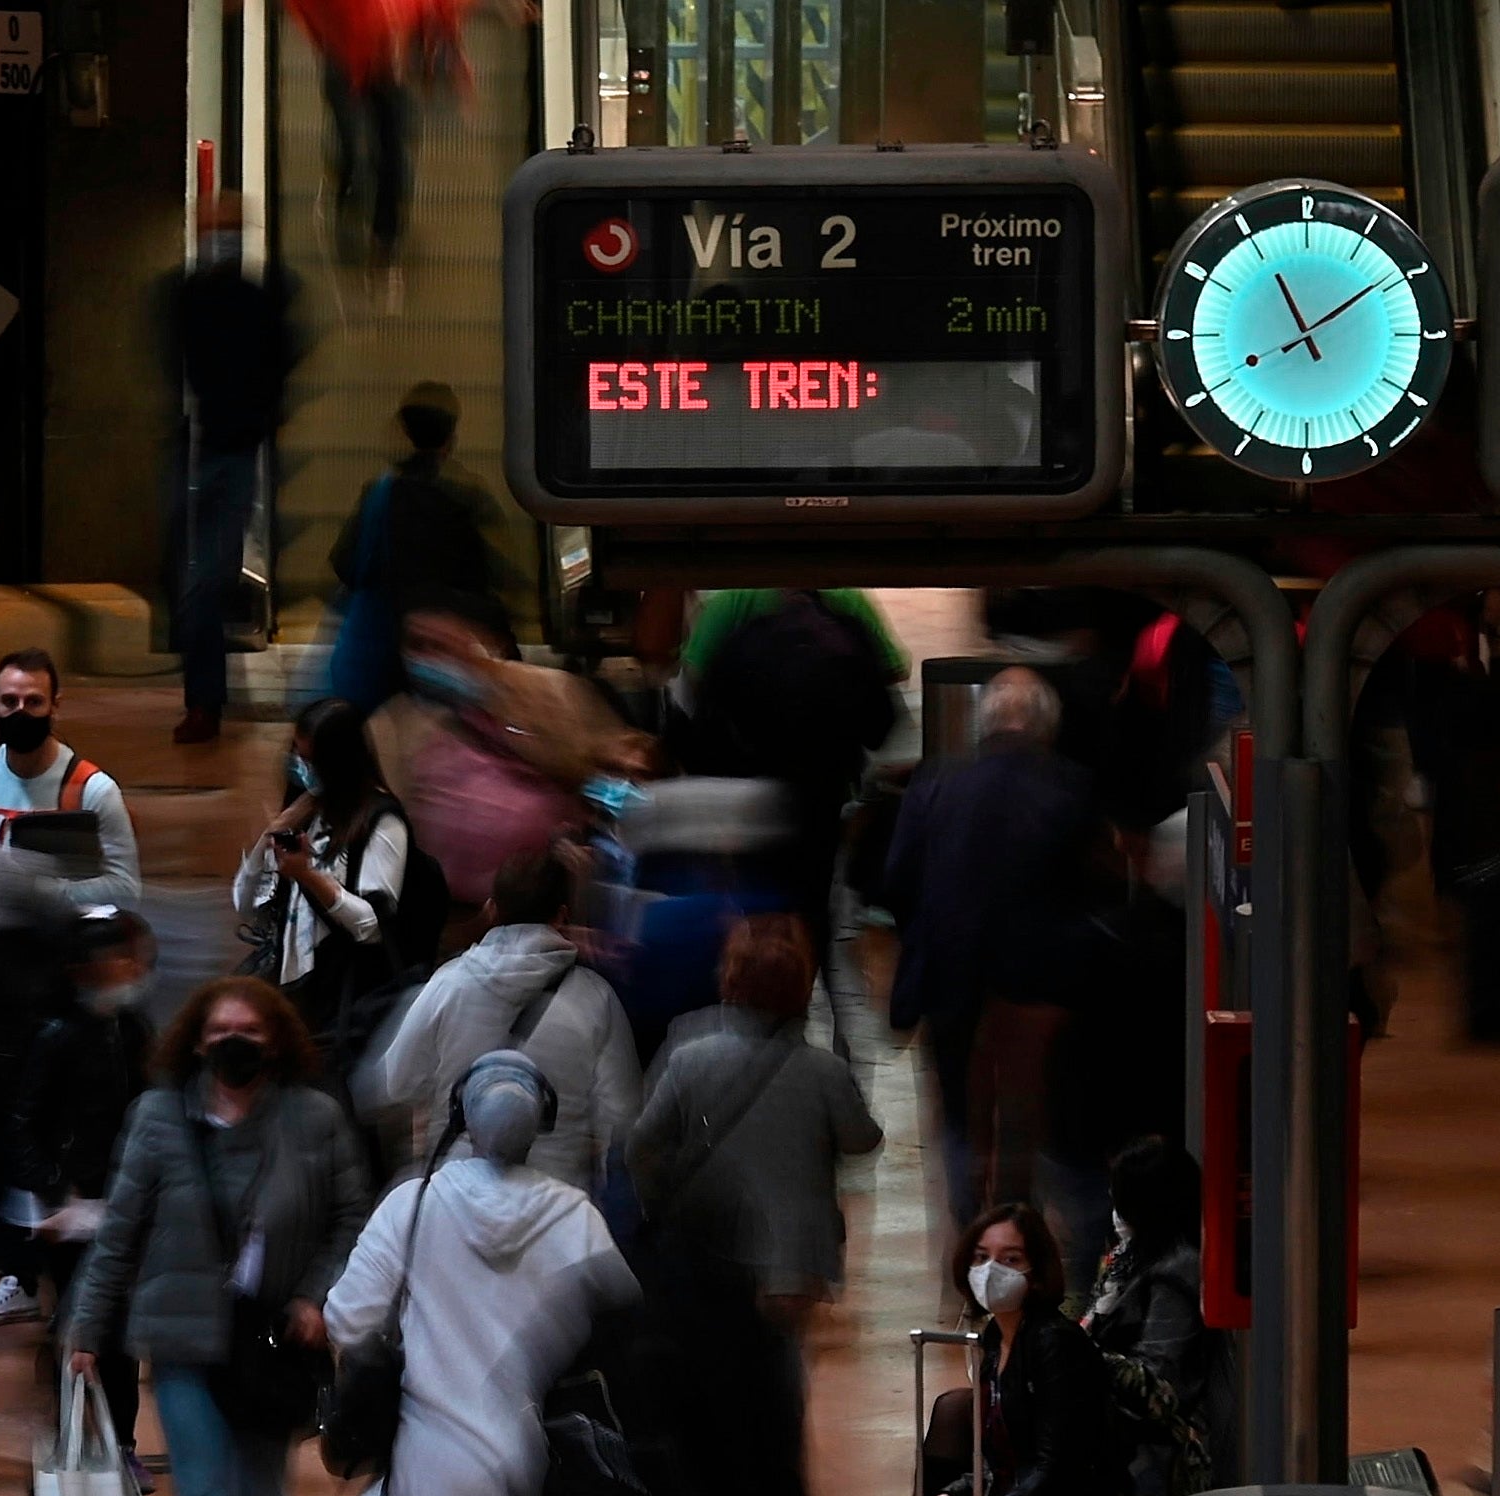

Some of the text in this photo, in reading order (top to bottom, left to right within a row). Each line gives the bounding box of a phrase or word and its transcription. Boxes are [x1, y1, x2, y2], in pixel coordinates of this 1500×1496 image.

[8, 15, 19, 41] 0
[0, 63, 30, 89] 500
[940, 213, 1063, 239] Próximo
[682, 213, 857, 269] Vía 2
[972, 242, 1032, 267] tren
[566, 297, 1048, 336] CHAMARTIN 2 min
[588, 361, 879, 411] ESTE TREN:
